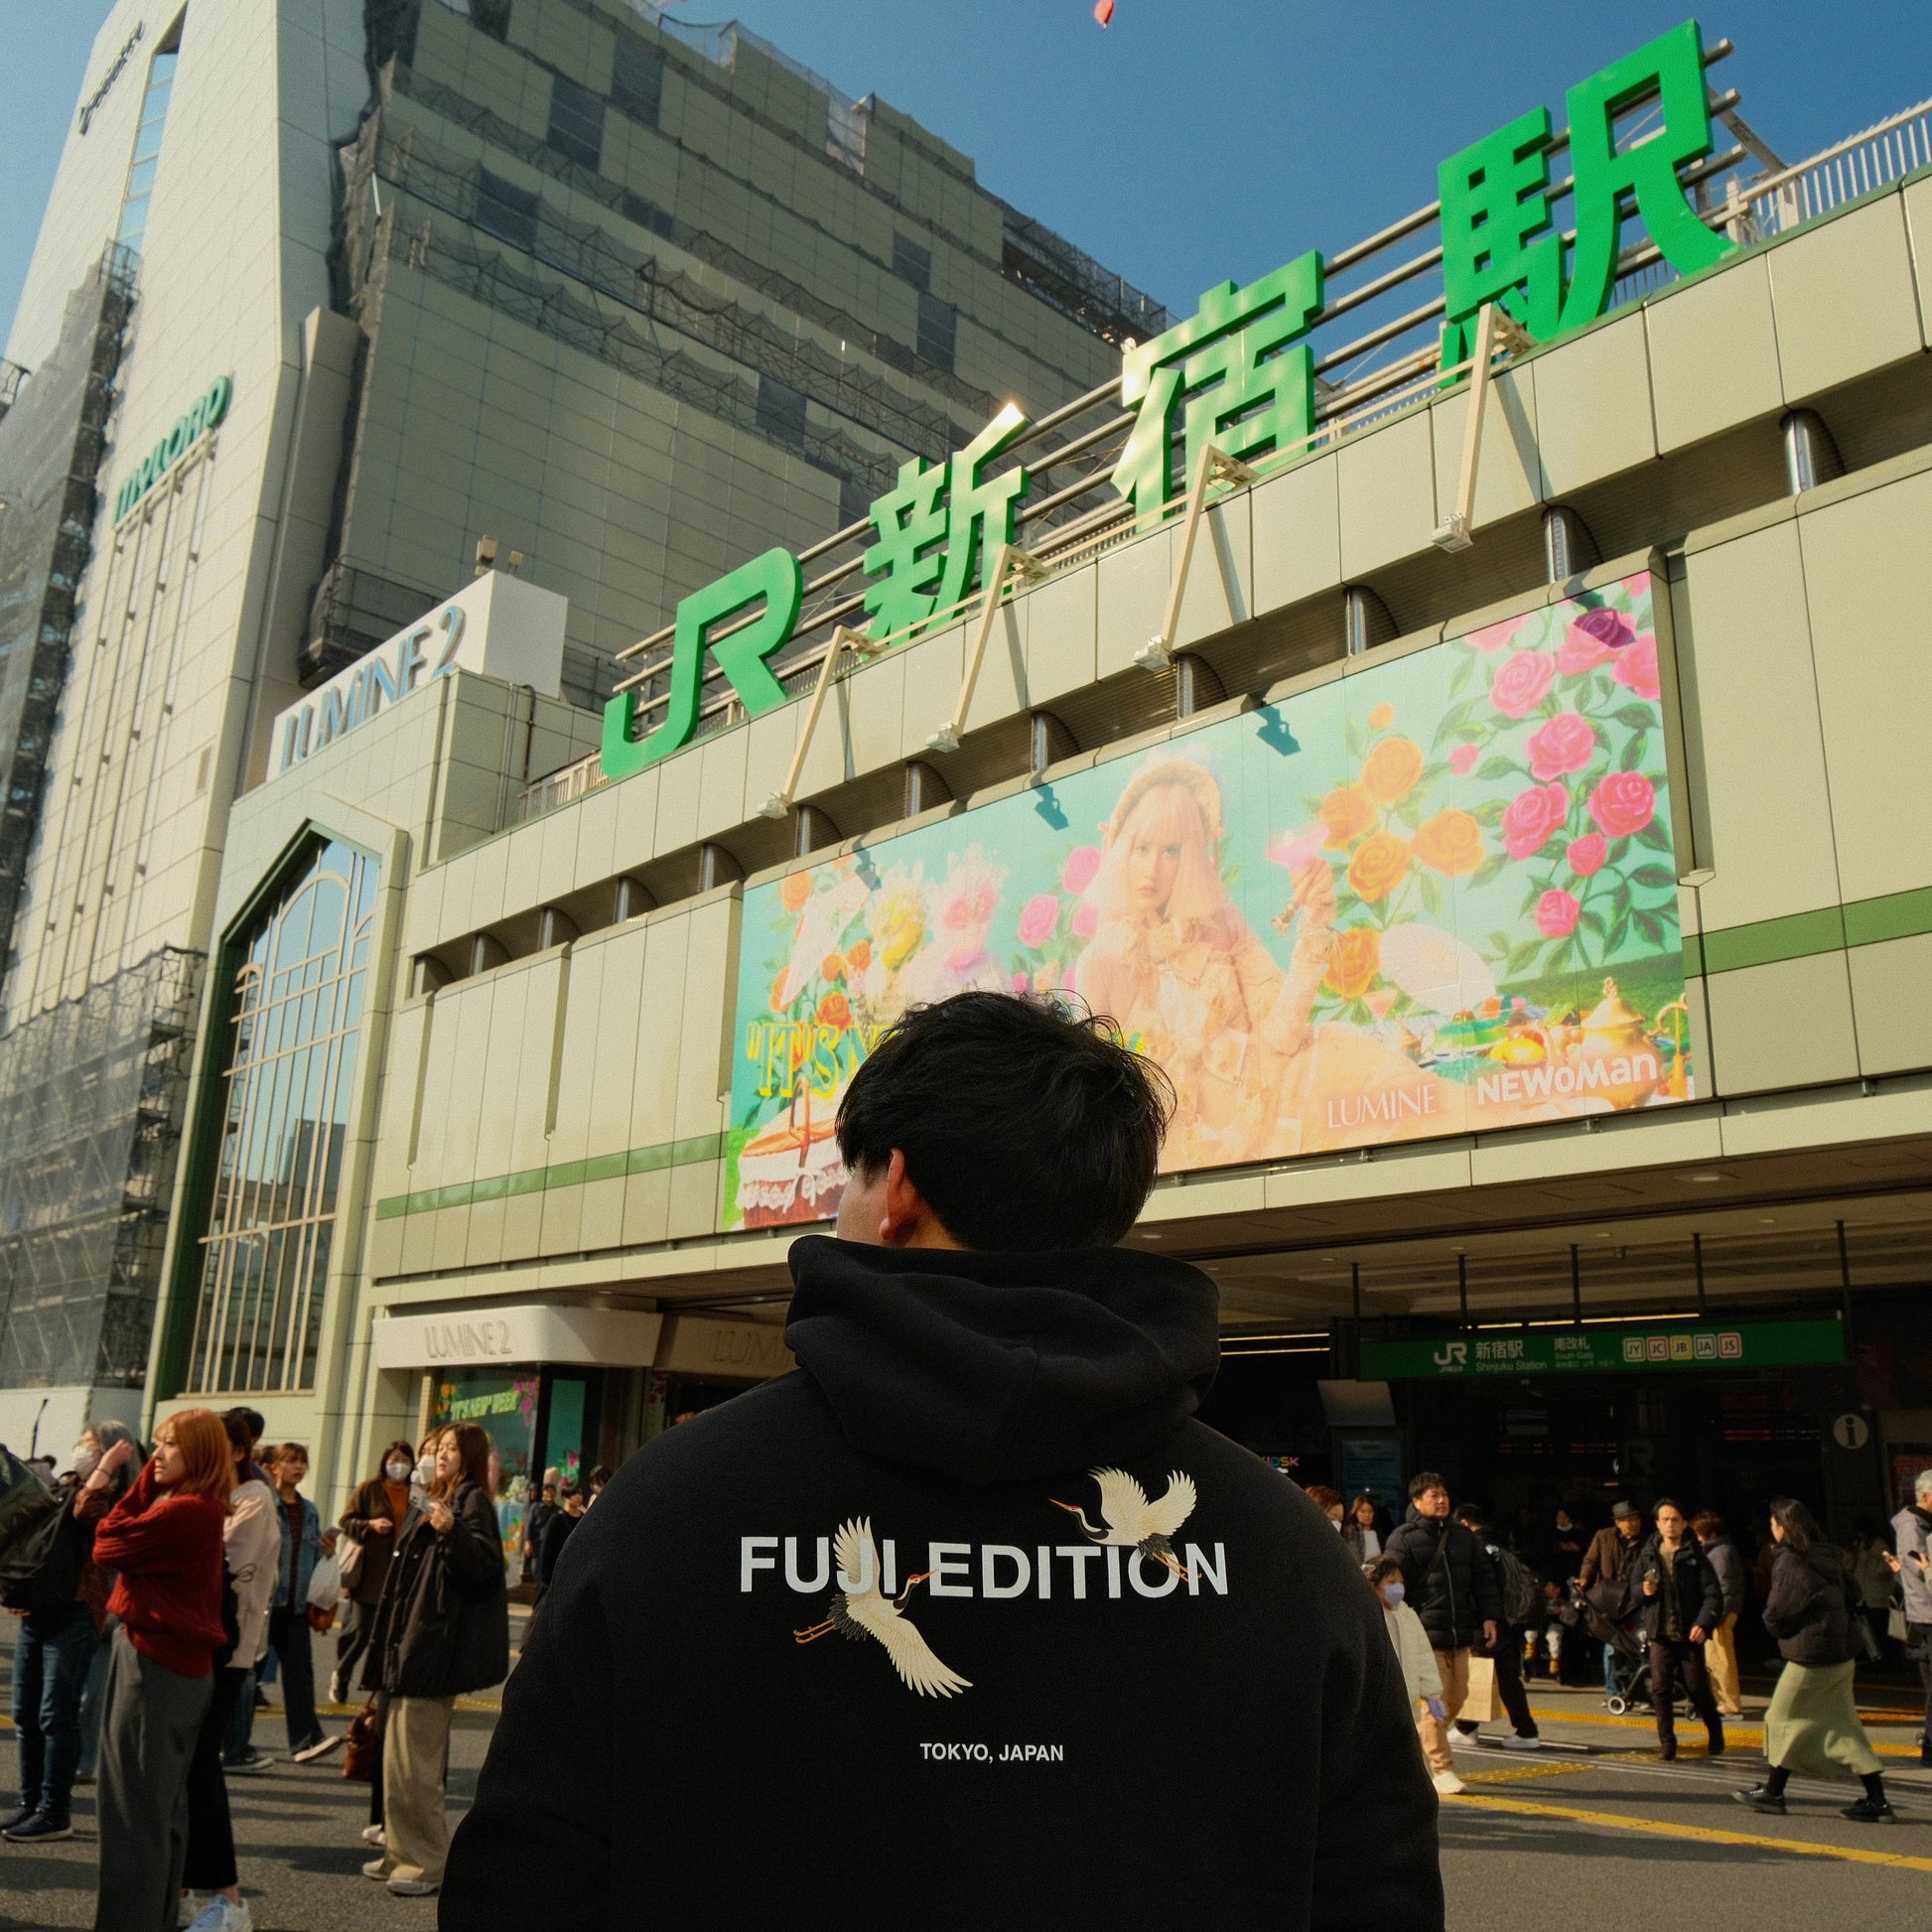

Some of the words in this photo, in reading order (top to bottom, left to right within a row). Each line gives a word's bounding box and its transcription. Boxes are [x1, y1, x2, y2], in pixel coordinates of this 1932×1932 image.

[431, 604, 467, 679] 2
[1326, 1082, 1439, 1130] LUMINE
[423, 1321, 496, 1359] LUMINE
[497, 1319, 512, 1354] 2
[1475, 1339, 1525, 1360] 新宿駅
[1433, 1341, 1467, 1366] JR
[1476, 1361, 1514, 1374] Shinjuku
[1516, 1360, 1548, 1371] Station
[1262, 1454, 1301, 1468] IOSK
[740, 1535, 897, 1595] FUJI
[927, 1541, 1229, 1600] EDITION
[919, 1742, 994, 1765] TOKYO,
[998, 1743, 1064, 1763] JAPAN
